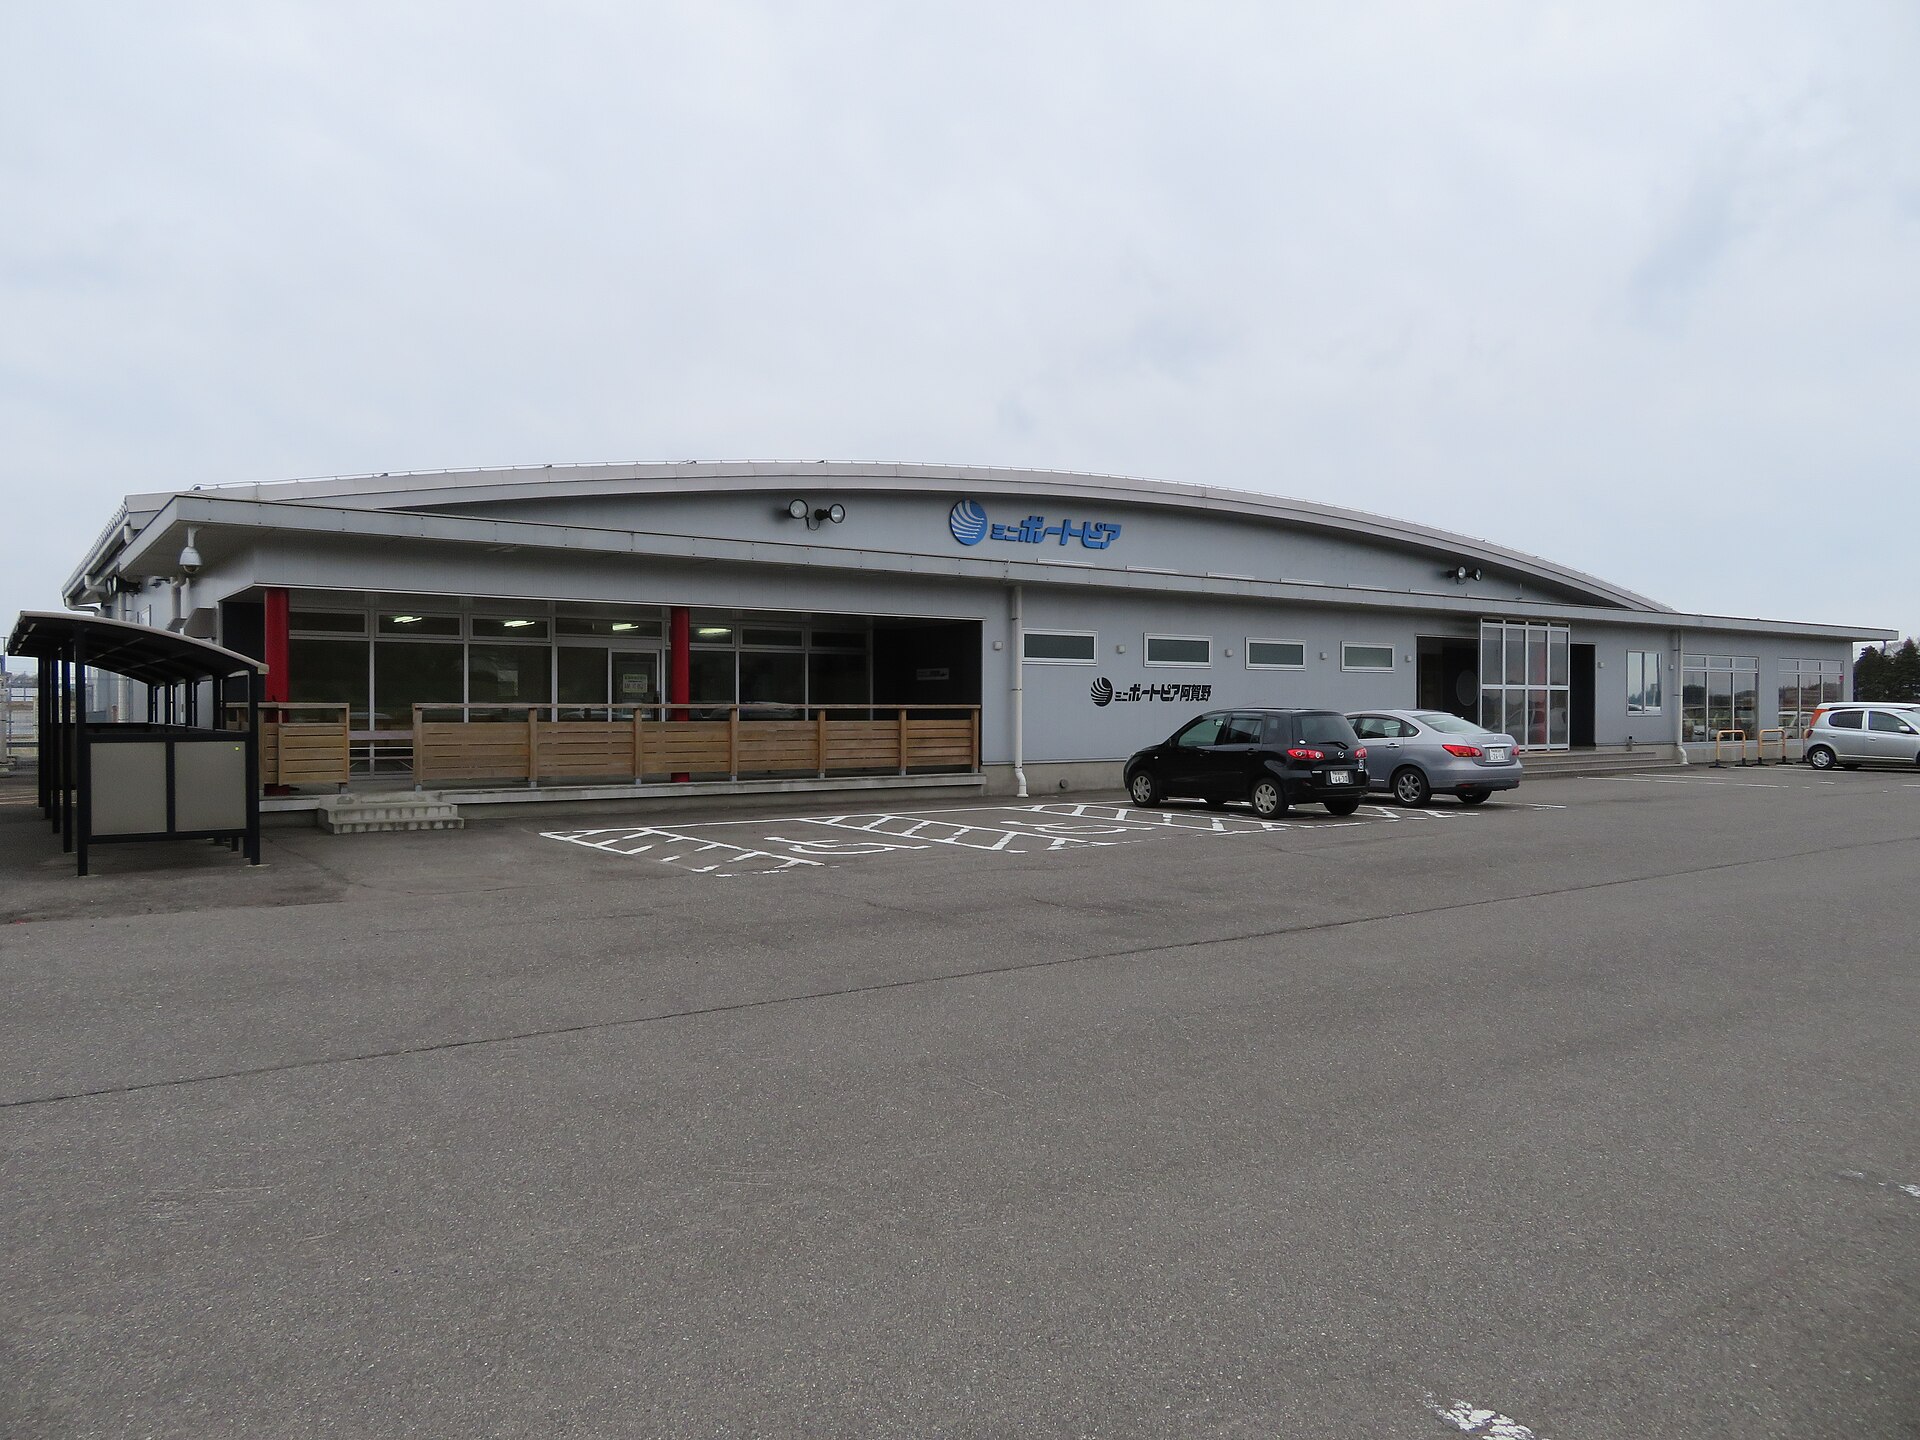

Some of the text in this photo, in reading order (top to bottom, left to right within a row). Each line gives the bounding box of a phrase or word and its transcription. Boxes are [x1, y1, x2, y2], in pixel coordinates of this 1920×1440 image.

[991, 515, 1122, 549] ミニボートピア
[1115, 683, 1211, 702] ミニボートピア阿賀野
